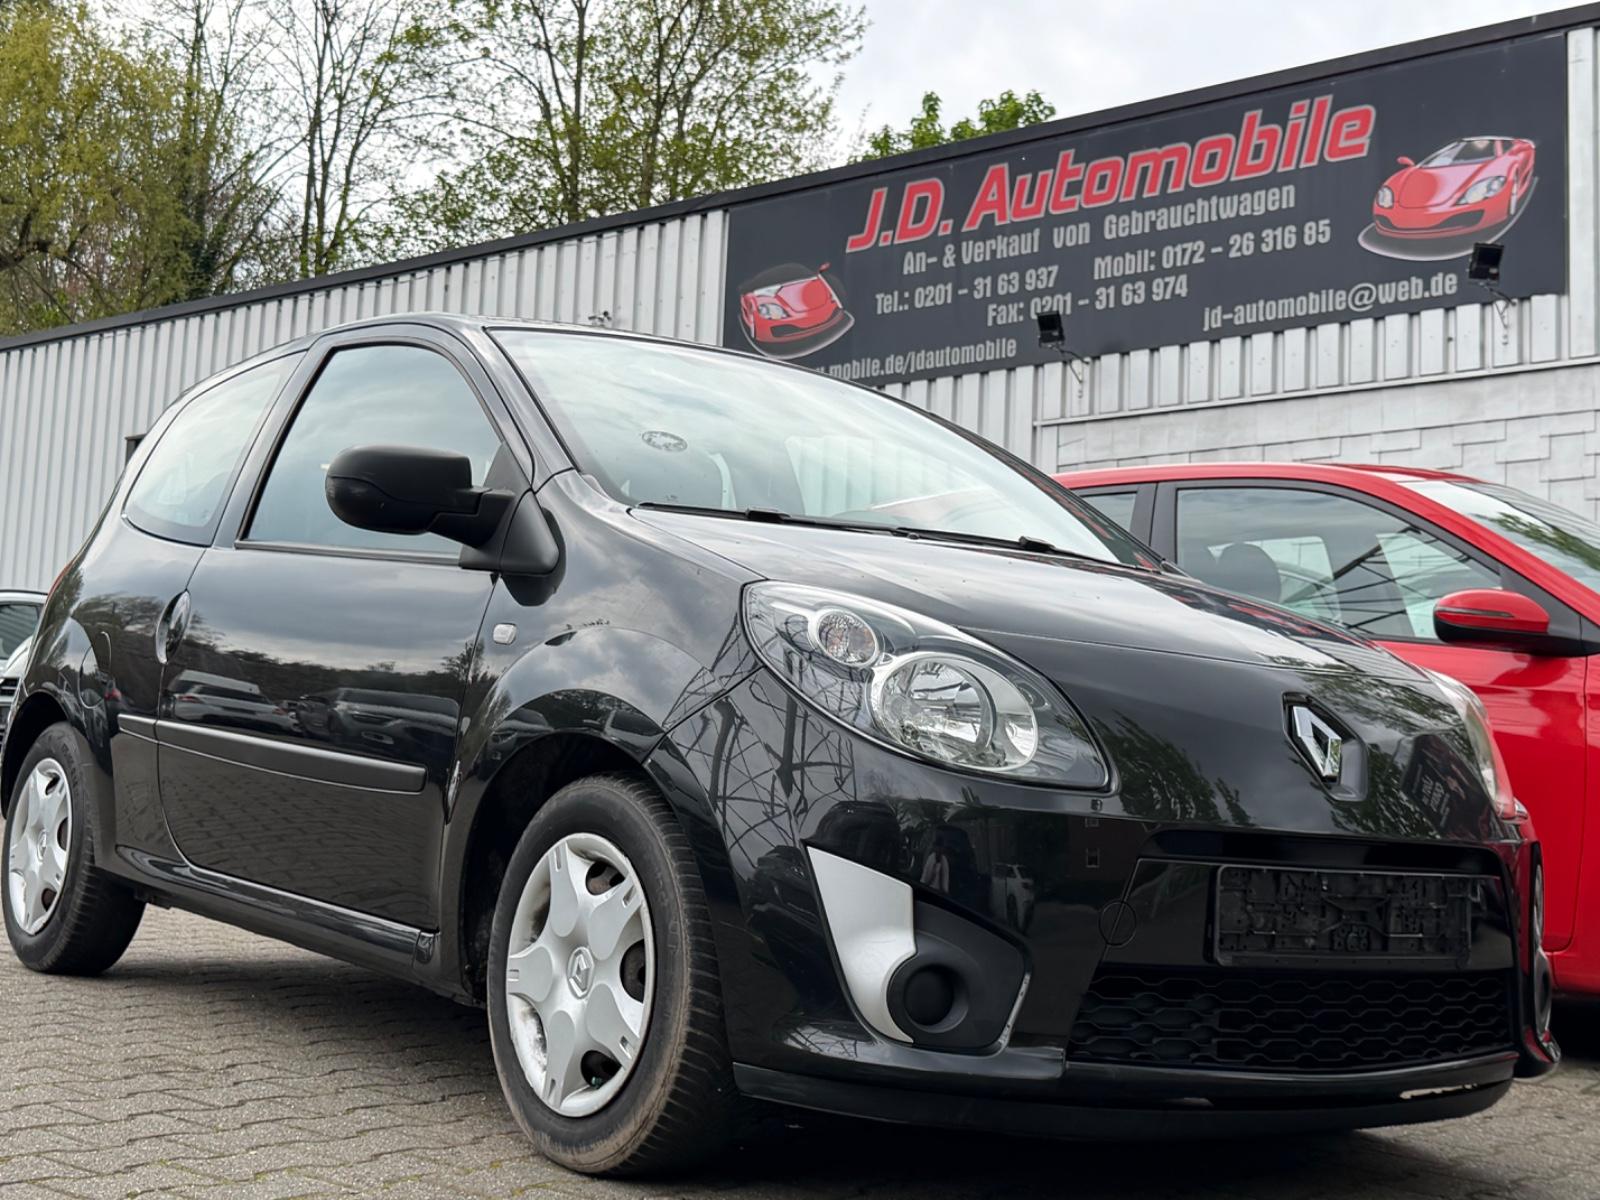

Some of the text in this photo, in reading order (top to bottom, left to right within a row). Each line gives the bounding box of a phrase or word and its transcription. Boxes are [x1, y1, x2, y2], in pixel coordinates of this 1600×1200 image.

[846, 95, 1377, 253] J.D. Automobile
[903, 185, 1295, 275] An- & Verkauf von Gebrauchtwagen
[1094, 249, 1156, 280] Mobil:
[1162, 241, 1205, 269] 0172
[1229, 232, 1254, 258] 26
[1261, 225, 1297, 251] 316
[1303, 219, 1331, 246] 85
[876, 290, 909, 315] Tel.:
[915, 281, 952, 308] 0201
[973, 277, 991, 299] 31
[997, 271, 1020, 296] 63
[1025, 265, 1058, 291] 937
[987, 301, 1024, 327] Fax:
[1030, 291, 1072, 320] 0201
[1095, 284, 1115, 310] 31
[1121, 279, 1146, 305] 63
[1152, 274, 1188, 301] 974
[1203, 273, 1458, 331] jd-automobile@web.de
